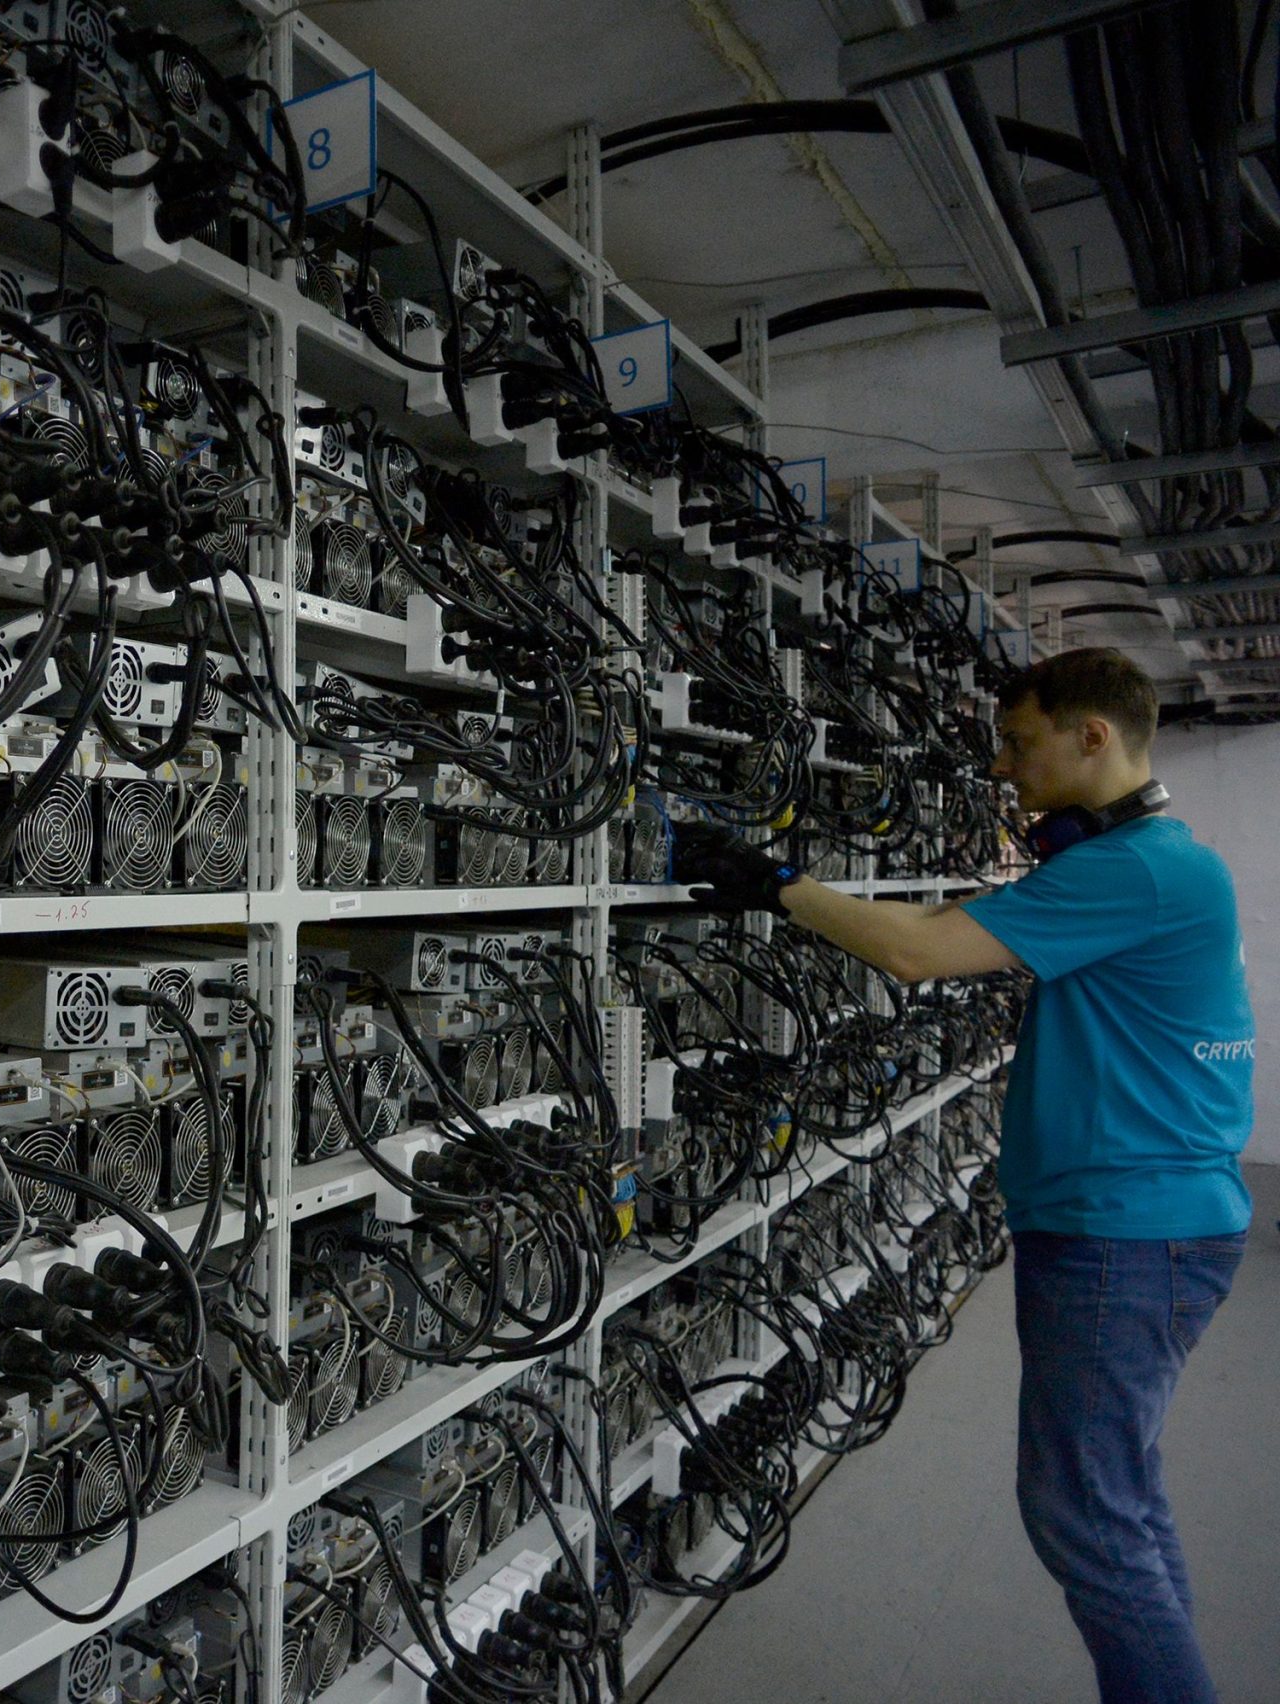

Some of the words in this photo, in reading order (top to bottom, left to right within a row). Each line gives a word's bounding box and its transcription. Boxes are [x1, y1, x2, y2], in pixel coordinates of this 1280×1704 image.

[307, 127, 332, 171] 8
[618, 357, 638, 388] 9
[879, 558, 903, 576] 11
